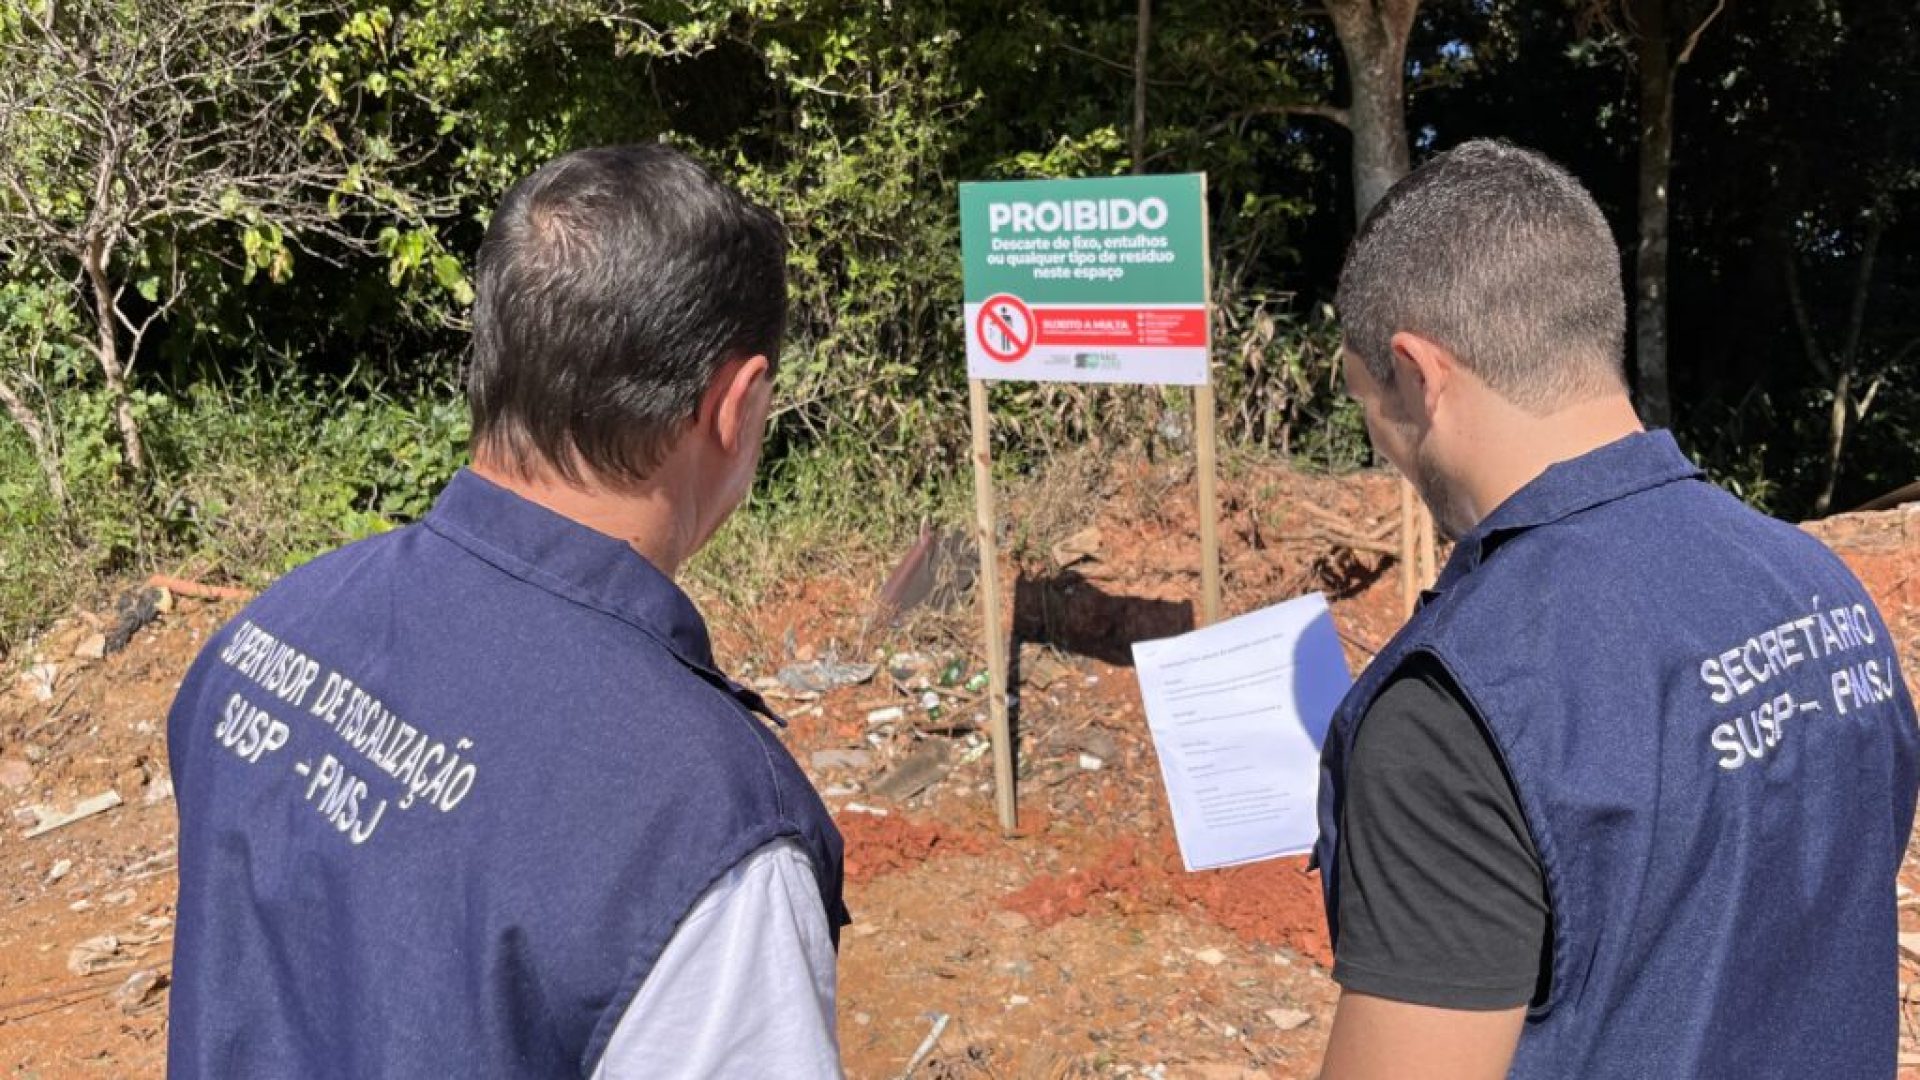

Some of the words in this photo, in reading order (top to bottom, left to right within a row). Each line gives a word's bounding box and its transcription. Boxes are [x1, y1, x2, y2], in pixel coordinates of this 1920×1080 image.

[989, 197, 1168, 232] PROIBIDO
[992, 238, 1050, 250] Descarte
[1053, 236, 1071, 249] de
[1072, 235, 1101, 250] lixo,
[1104, 234, 1167, 248] entulhos
[987, 253, 1004, 265] ou
[1006, 251, 1066, 268] qualquer
[1069, 250, 1096, 267] tipo
[1098, 249, 1117, 263] de
[1119, 249, 1175, 263] resíduo
[1034, 267, 1071, 279] neste
[1074, 267, 1124, 280] espaço
[1701, 595, 1875, 703] SECRETÁRIO
[221, 620, 319, 706] SUPERVISOR
[310, 672, 352, 723] DE
[335, 687, 477, 812] FISCALIZAÇÃO
[1712, 692, 1794, 769] SUSP
[1832, 656, 1893, 715] PMSJ
[215, 693, 290, 763] SUSP
[306, 754, 387, 844] PMSJ
